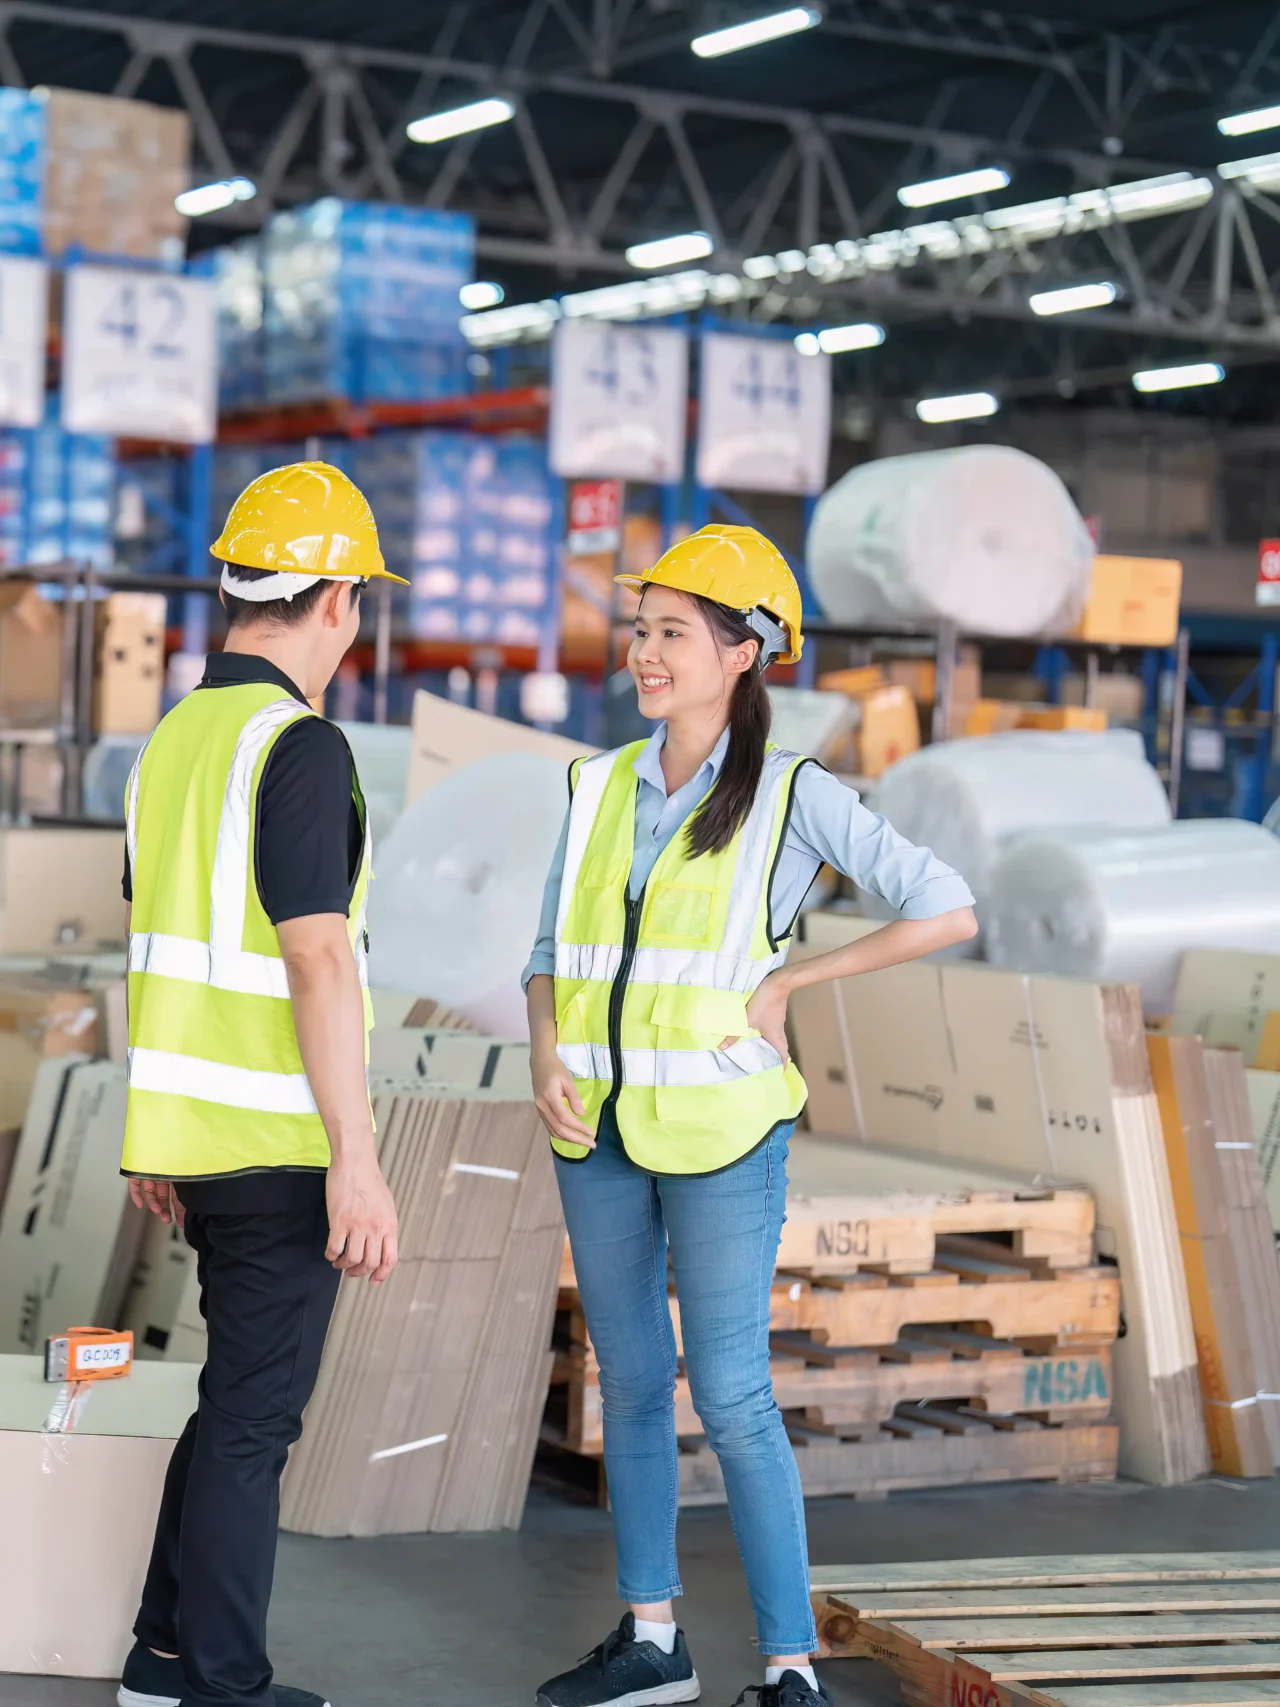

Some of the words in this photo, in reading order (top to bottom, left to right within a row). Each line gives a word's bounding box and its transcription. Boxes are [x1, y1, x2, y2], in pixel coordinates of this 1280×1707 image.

[96, 280, 188, 360] 42
[582, 328, 661, 408] 43
[732, 350, 803, 416] 44
[1024, 1360, 1109, 1405] NSA
